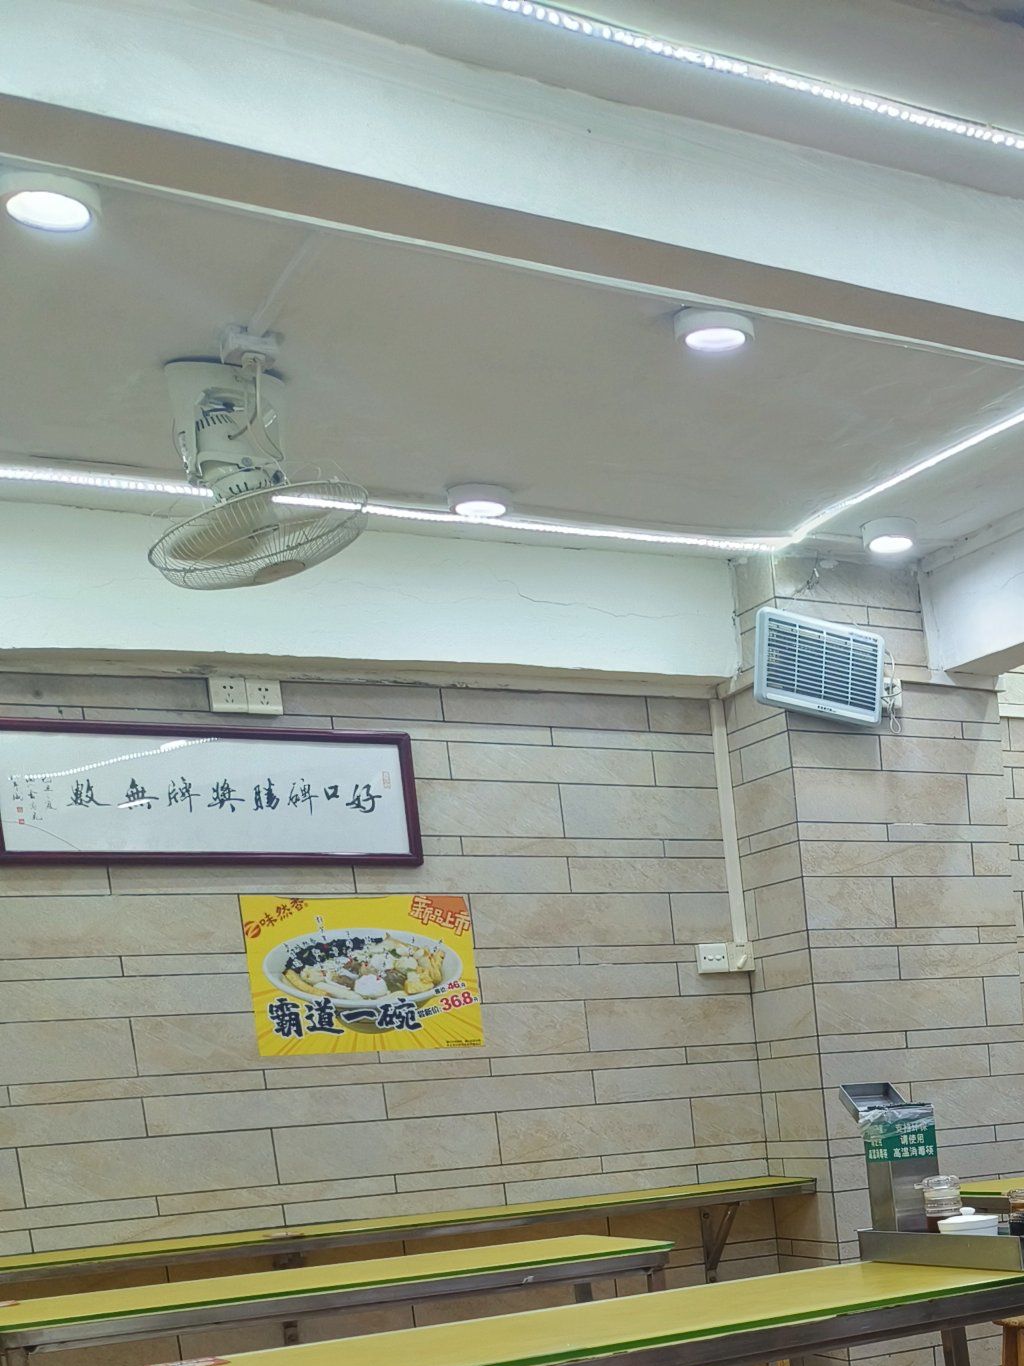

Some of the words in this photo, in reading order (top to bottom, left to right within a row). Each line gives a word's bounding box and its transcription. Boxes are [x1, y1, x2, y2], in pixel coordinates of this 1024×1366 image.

[259, 897, 306, 927] 味然香
[410, 895, 471, 937] 新品上市
[267, 997, 423, 1039] 霸道一碗
[893, 1145, 934, 1158] 高温消毒筷
[900, 1133, 925, 1146] 请使用
